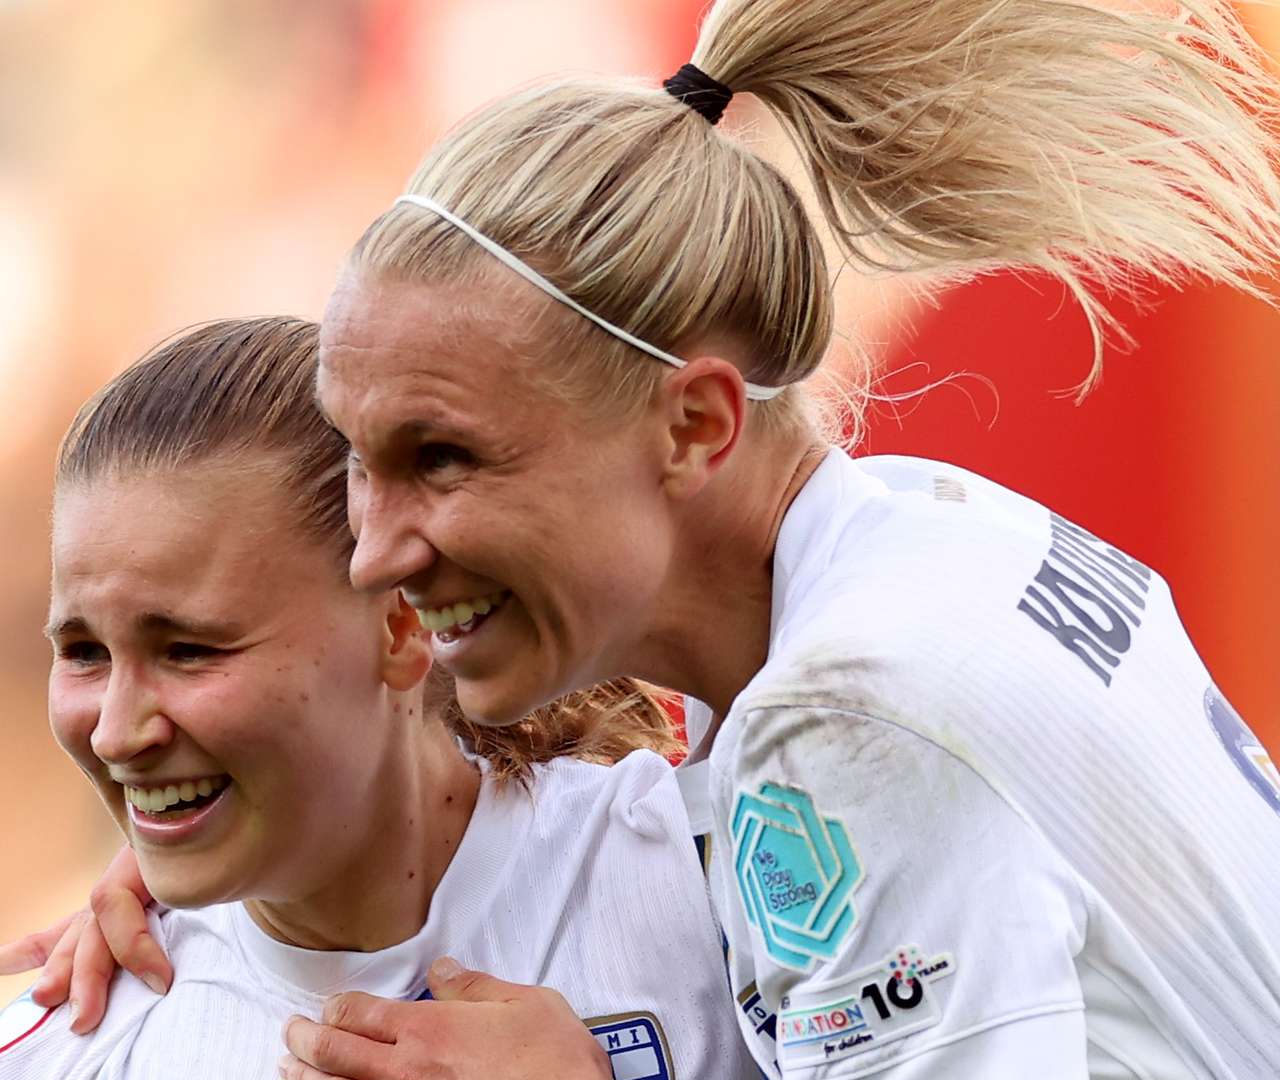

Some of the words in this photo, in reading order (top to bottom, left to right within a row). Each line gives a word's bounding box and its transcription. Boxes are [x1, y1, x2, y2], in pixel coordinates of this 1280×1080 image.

[755, 850, 774, 865] We
[762, 870, 791, 889] Play
[769, 882, 817, 909] Strong
[861, 974, 923, 1020] 10
[917, 961, 949, 977] YEARS
[606, 1028, 640, 1049] MI
